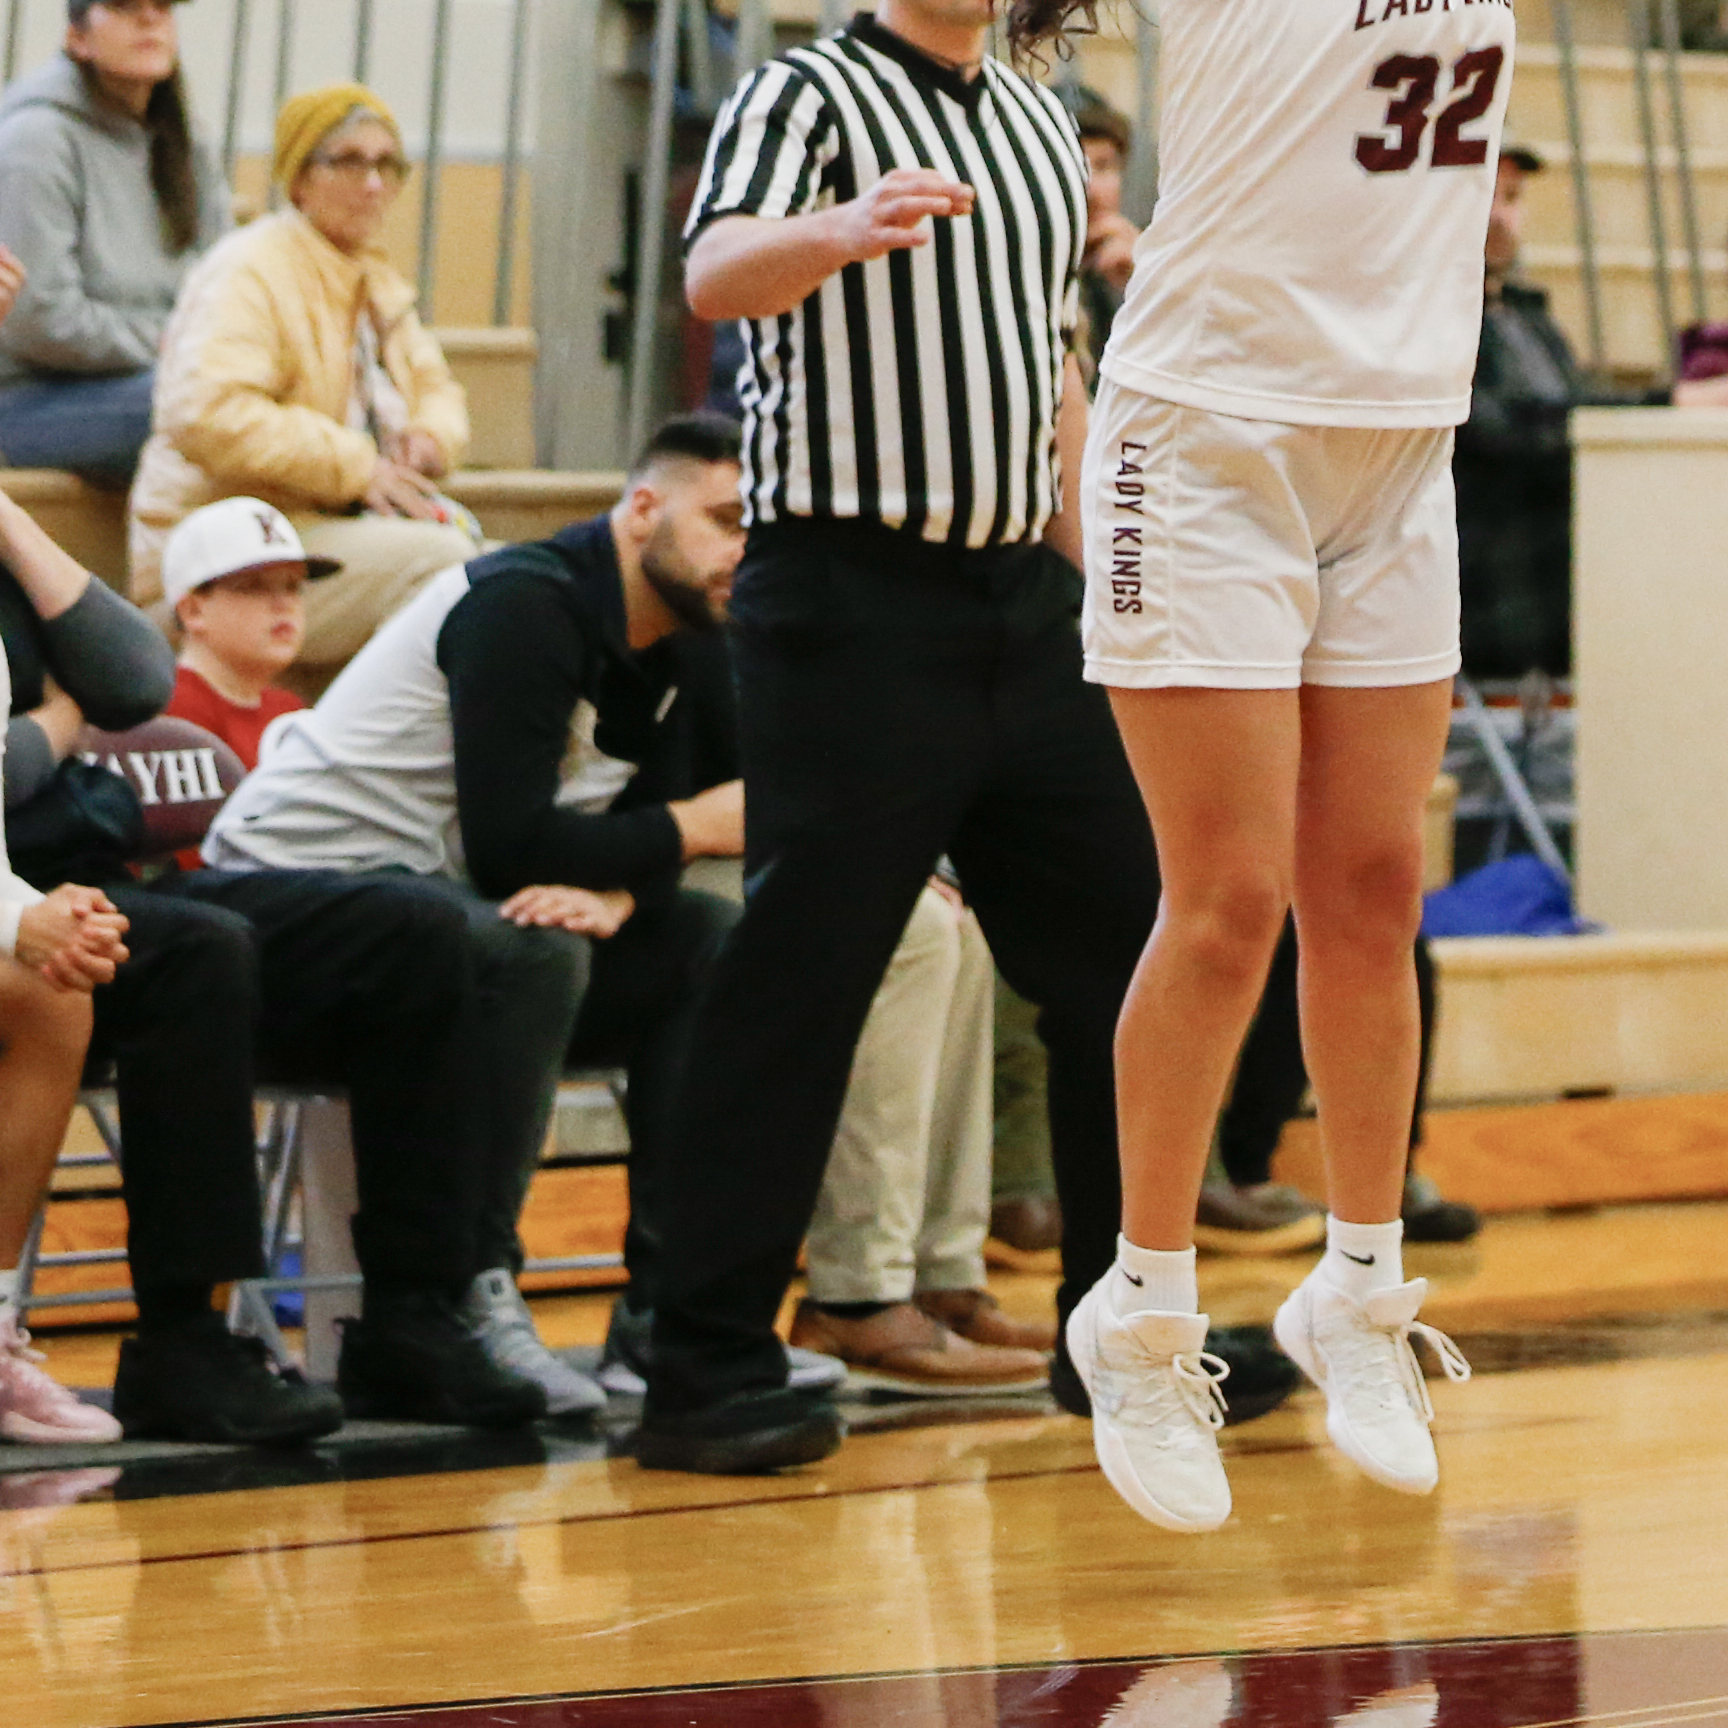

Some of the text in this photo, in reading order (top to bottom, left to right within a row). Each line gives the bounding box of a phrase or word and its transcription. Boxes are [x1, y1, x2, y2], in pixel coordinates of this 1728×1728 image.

[1354, 44, 1504, 174] 32
[1114, 440, 1147, 516] LADY
[1111, 527, 1143, 614] KINGS
